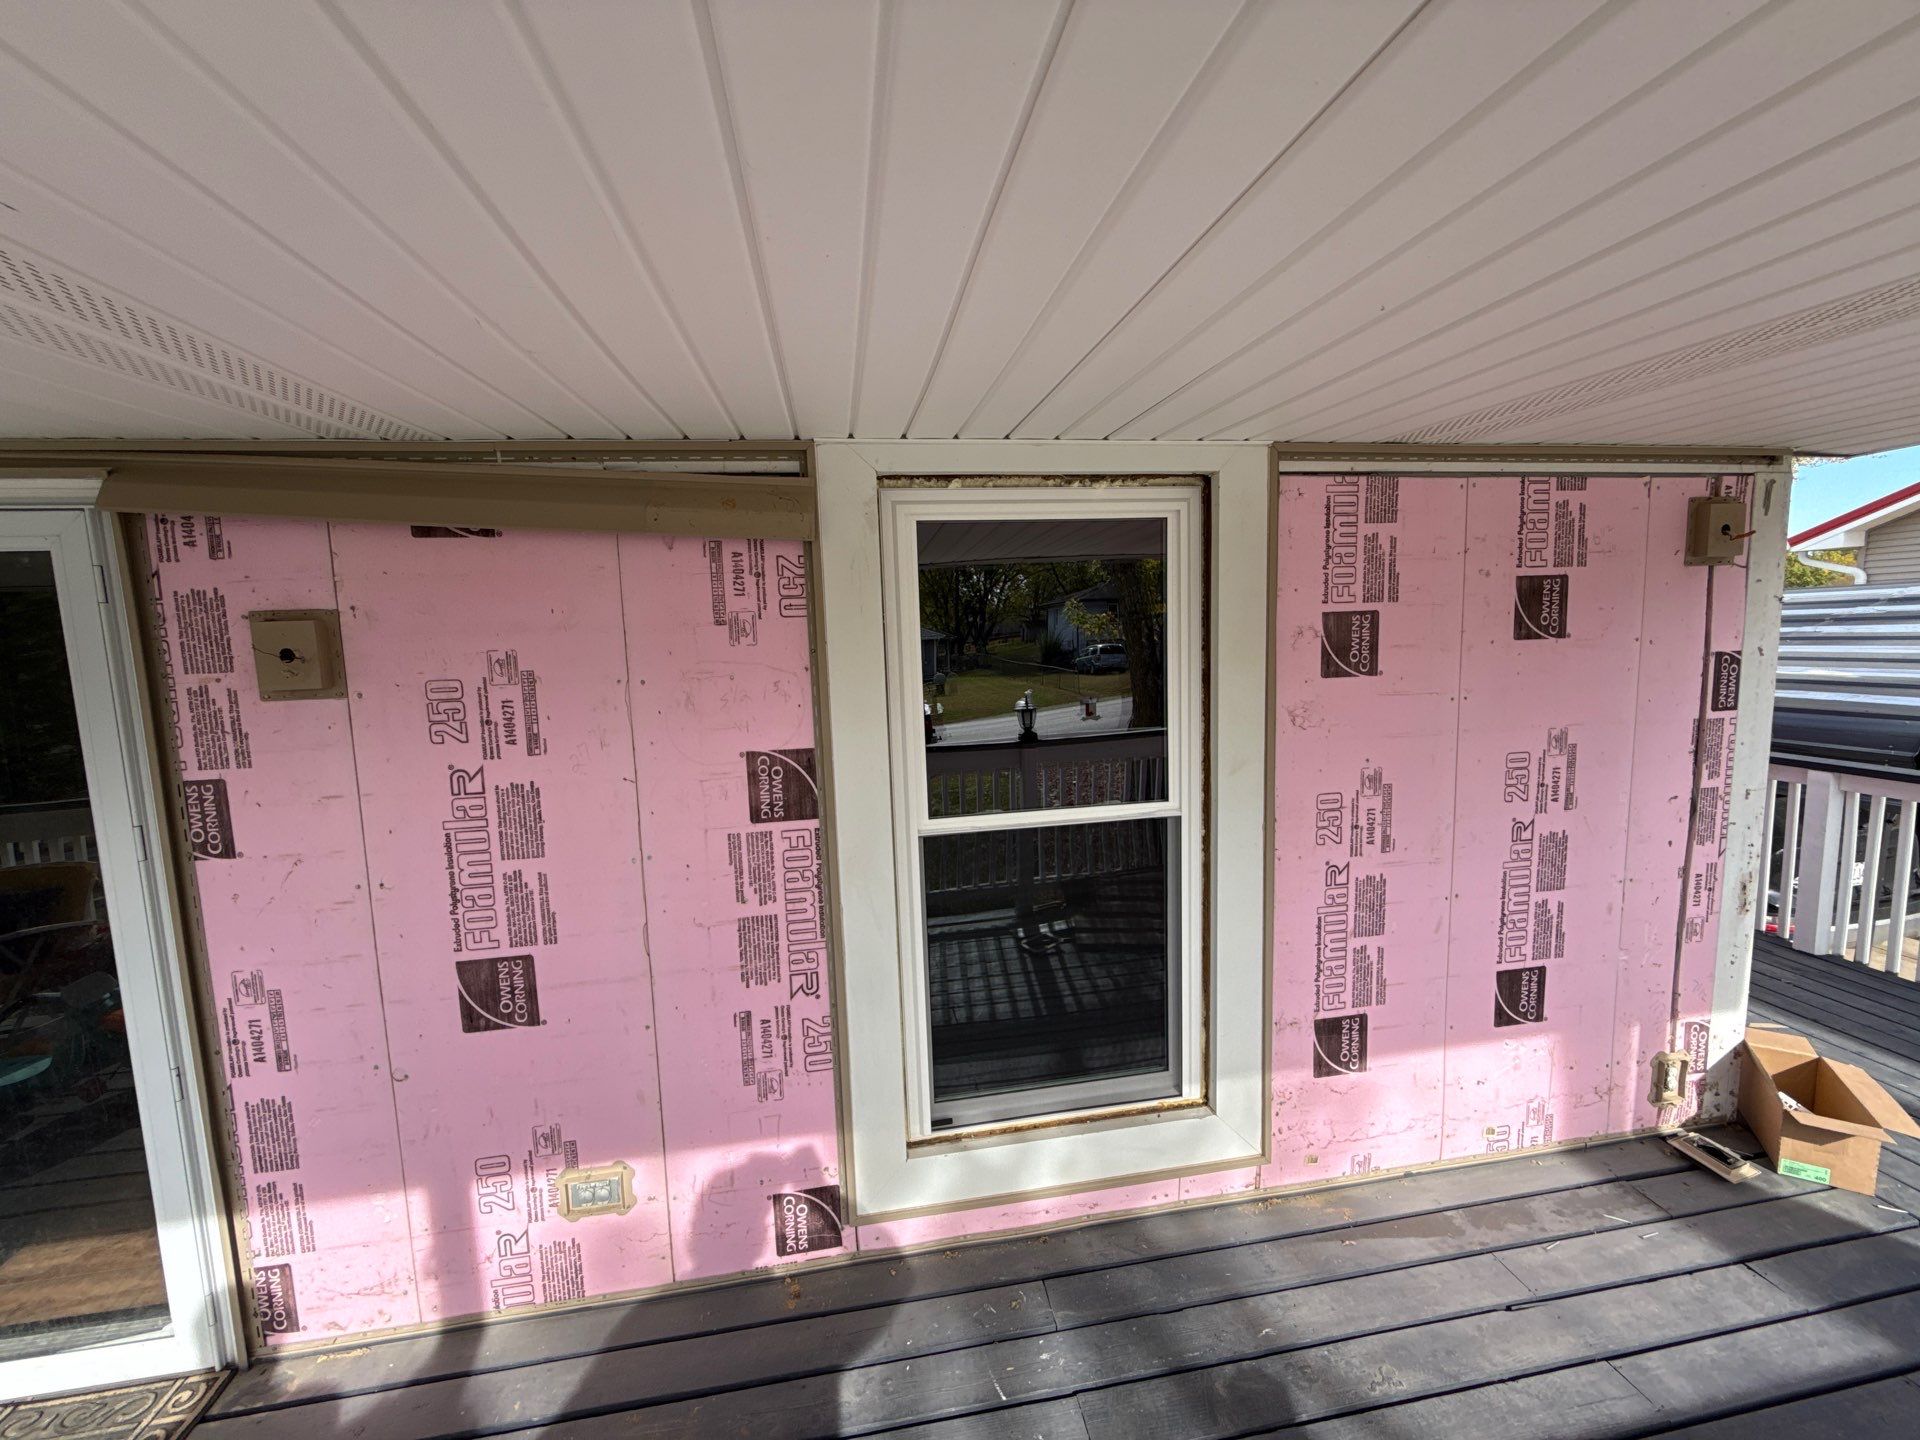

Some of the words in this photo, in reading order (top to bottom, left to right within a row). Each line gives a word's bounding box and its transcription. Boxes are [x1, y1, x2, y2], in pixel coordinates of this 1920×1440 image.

[180, 515, 198, 547] A1404
[1518, 497, 1526, 535] Polystyrene
[1323, 530, 1332, 570] Polystyrene
[731, 552, 745, 597] A1404271
[776, 555, 808, 618] 250
[1541, 579, 1551, 625] OWENS
[1550, 579, 1560, 634] CORNING
[1350, 615, 1360, 662] OWENS
[1360, 614, 1370, 672] CORNING
[1718, 656, 1730, 708] CORNING
[1726, 664, 1738, 707] OWENS
[425, 680, 469, 744] 250
[501, 699, 518, 746] A1404271
[757, 756, 770, 819] CORNING
[768, 765, 785, 819] OWENS
[1504, 752, 1530, 802] 250
[1551, 767, 1560, 802] A1404271
[186, 785, 204, 843] OWENS
[201, 784, 223, 854] CORNING
[1316, 792, 1342, 846] 250
[1366, 808, 1376, 845] A1404271
[443, 833, 453, 870] Insulation
[446, 871, 460, 915] Polystyrene
[1692, 873, 1702, 907] A1404271
[450, 918, 462, 952] Extruded
[1498, 901, 1506, 935] Polystyrene
[498, 961, 512, 1013] OWENS
[1314, 947, 1322, 982] Polystyrene
[511, 960, 527, 1023] CORNING
[1519, 971, 1530, 1012] OWENS
[1528, 970, 1539, 1020] CORNING
[248, 1019, 267, 1063] A1404271
[760, 1019, 774, 1059] A1404271
[802, 1016, 833, 1073] 250
[1340, 1019, 1350, 1061] OWENS
[1349, 1018, 1360, 1069] CORNING
[1697, 1032, 1706, 1071] OWENS
[1486, 1125, 1510, 1152] 50
[475, 1155, 515, 1214] 250
[783, 1196, 796, 1252] CORNING
[796, 1204, 809, 1251] OWENS
[255, 1271, 269, 1320] OWENS
[268, 1268, 288, 1330] CORNING
